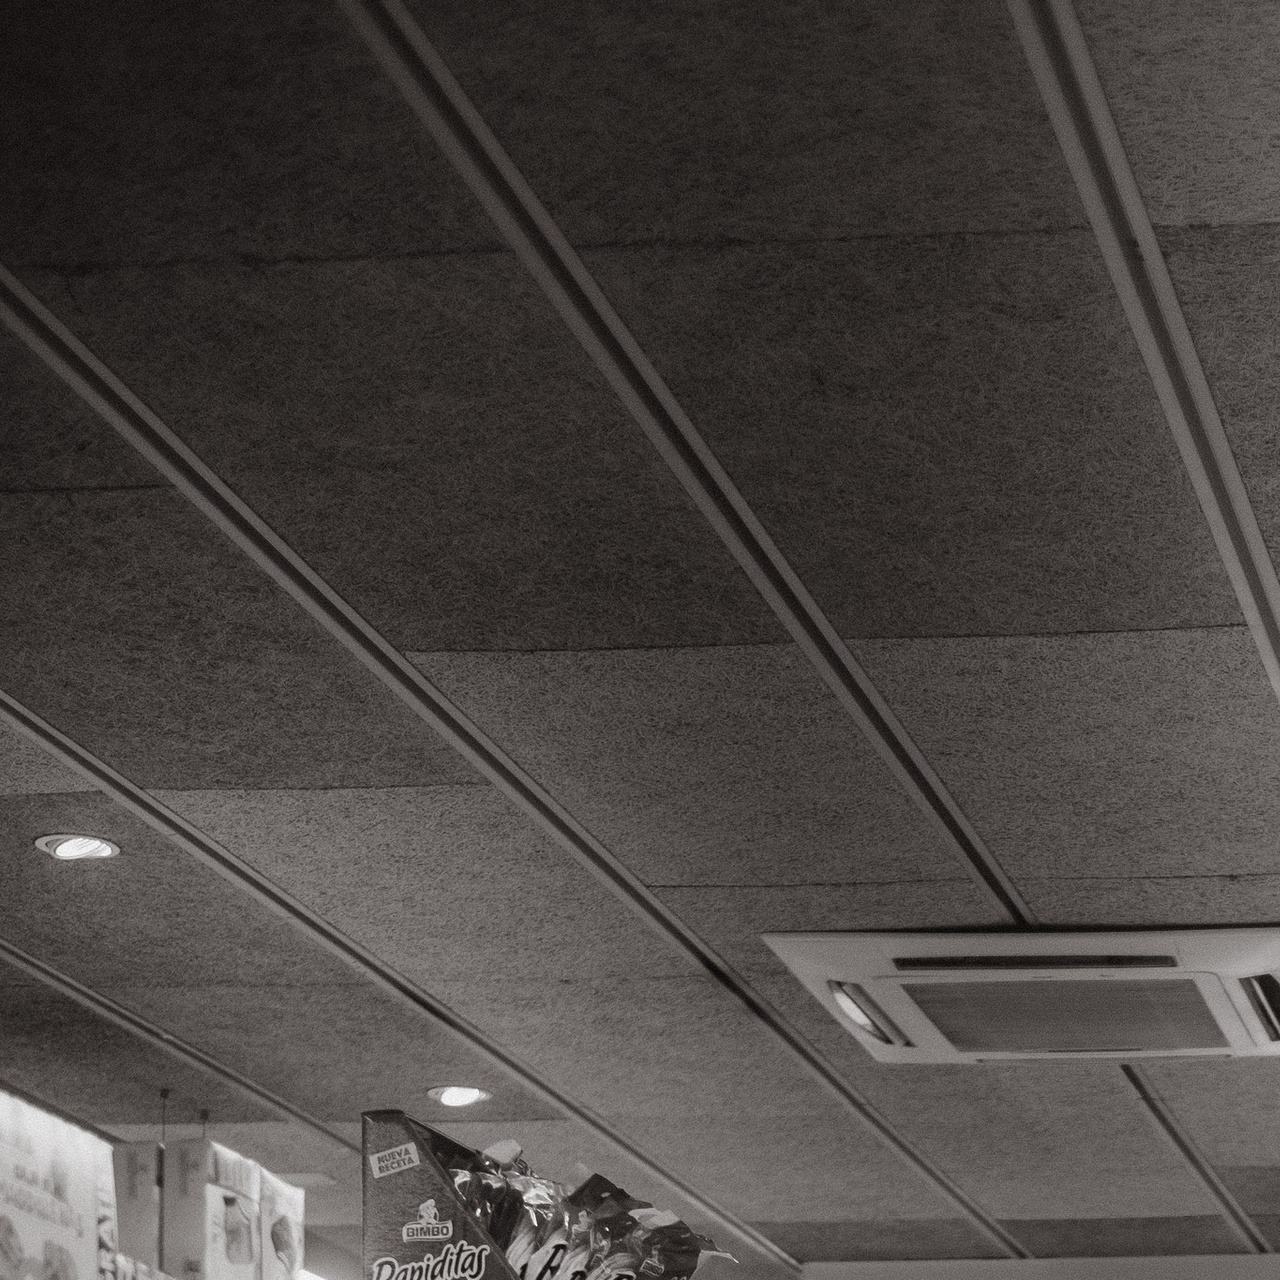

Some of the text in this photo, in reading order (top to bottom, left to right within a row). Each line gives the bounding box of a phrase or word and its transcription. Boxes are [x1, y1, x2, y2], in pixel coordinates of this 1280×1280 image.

[377, 1147, 411, 1164] NUEVA
[378, 1156, 415, 1174] RECETA
[406, 1226, 450, 1238] BIMBO
